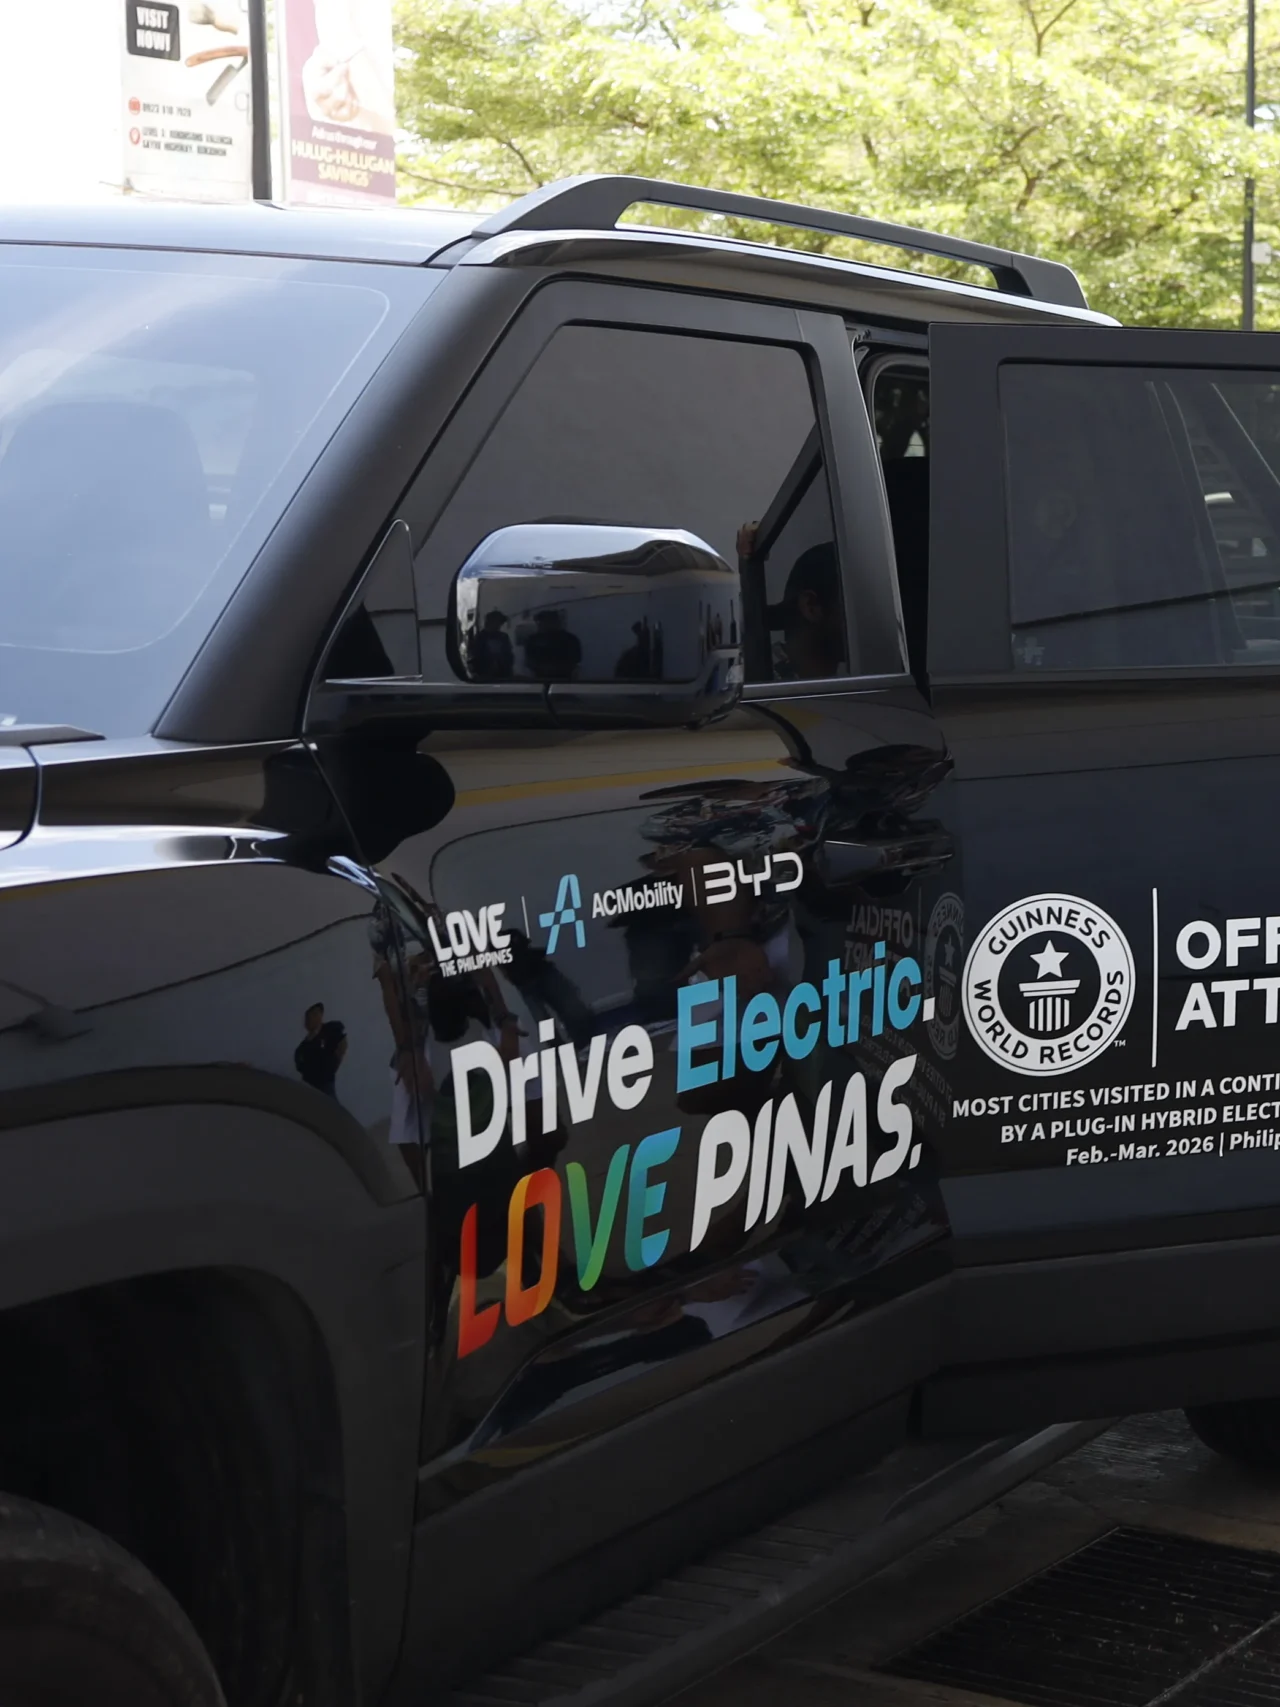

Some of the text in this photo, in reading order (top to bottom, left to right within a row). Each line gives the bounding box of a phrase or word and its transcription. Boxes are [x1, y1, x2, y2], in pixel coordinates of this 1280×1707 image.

[136, 6, 169, 29] VISIT
[136, 29, 171, 52] NOW!
[702, 851, 804, 905] BYD
[592, 881, 684, 919] ACMobility
[427, 903, 511, 961] LOVE
[988, 906, 1111, 955] GUINNESS
[439, 948, 513, 978] THE PHILIPPINES
[974, 979, 1029, 1060] WORLD
[1040, 970, 1125, 1065] RECORDS
[450, 1018, 654, 1169] Drive
[676, 940, 935, 1093] Electric.
[952, 1096, 1013, 1118] MOST
[1018, 1089, 1085, 1113] CITIES
[1090, 1082, 1170, 1106] VISITED
[1175, 1080, 1197, 1099] IN
[1200, 1079, 1215, 1097] A
[1000, 1124, 1028, 1143] BY
[1031, 1125, 1046, 1140] A
[1050, 1114, 1136, 1139] PLUG-IN
[1141, 1106, 1217, 1130] HYBRID
[1066, 1142, 1161, 1166] Feb.-Mar.
[1165, 1135, 1215, 1157] 2026
[457, 1054, 923, 1359] LOVE PINAS.
